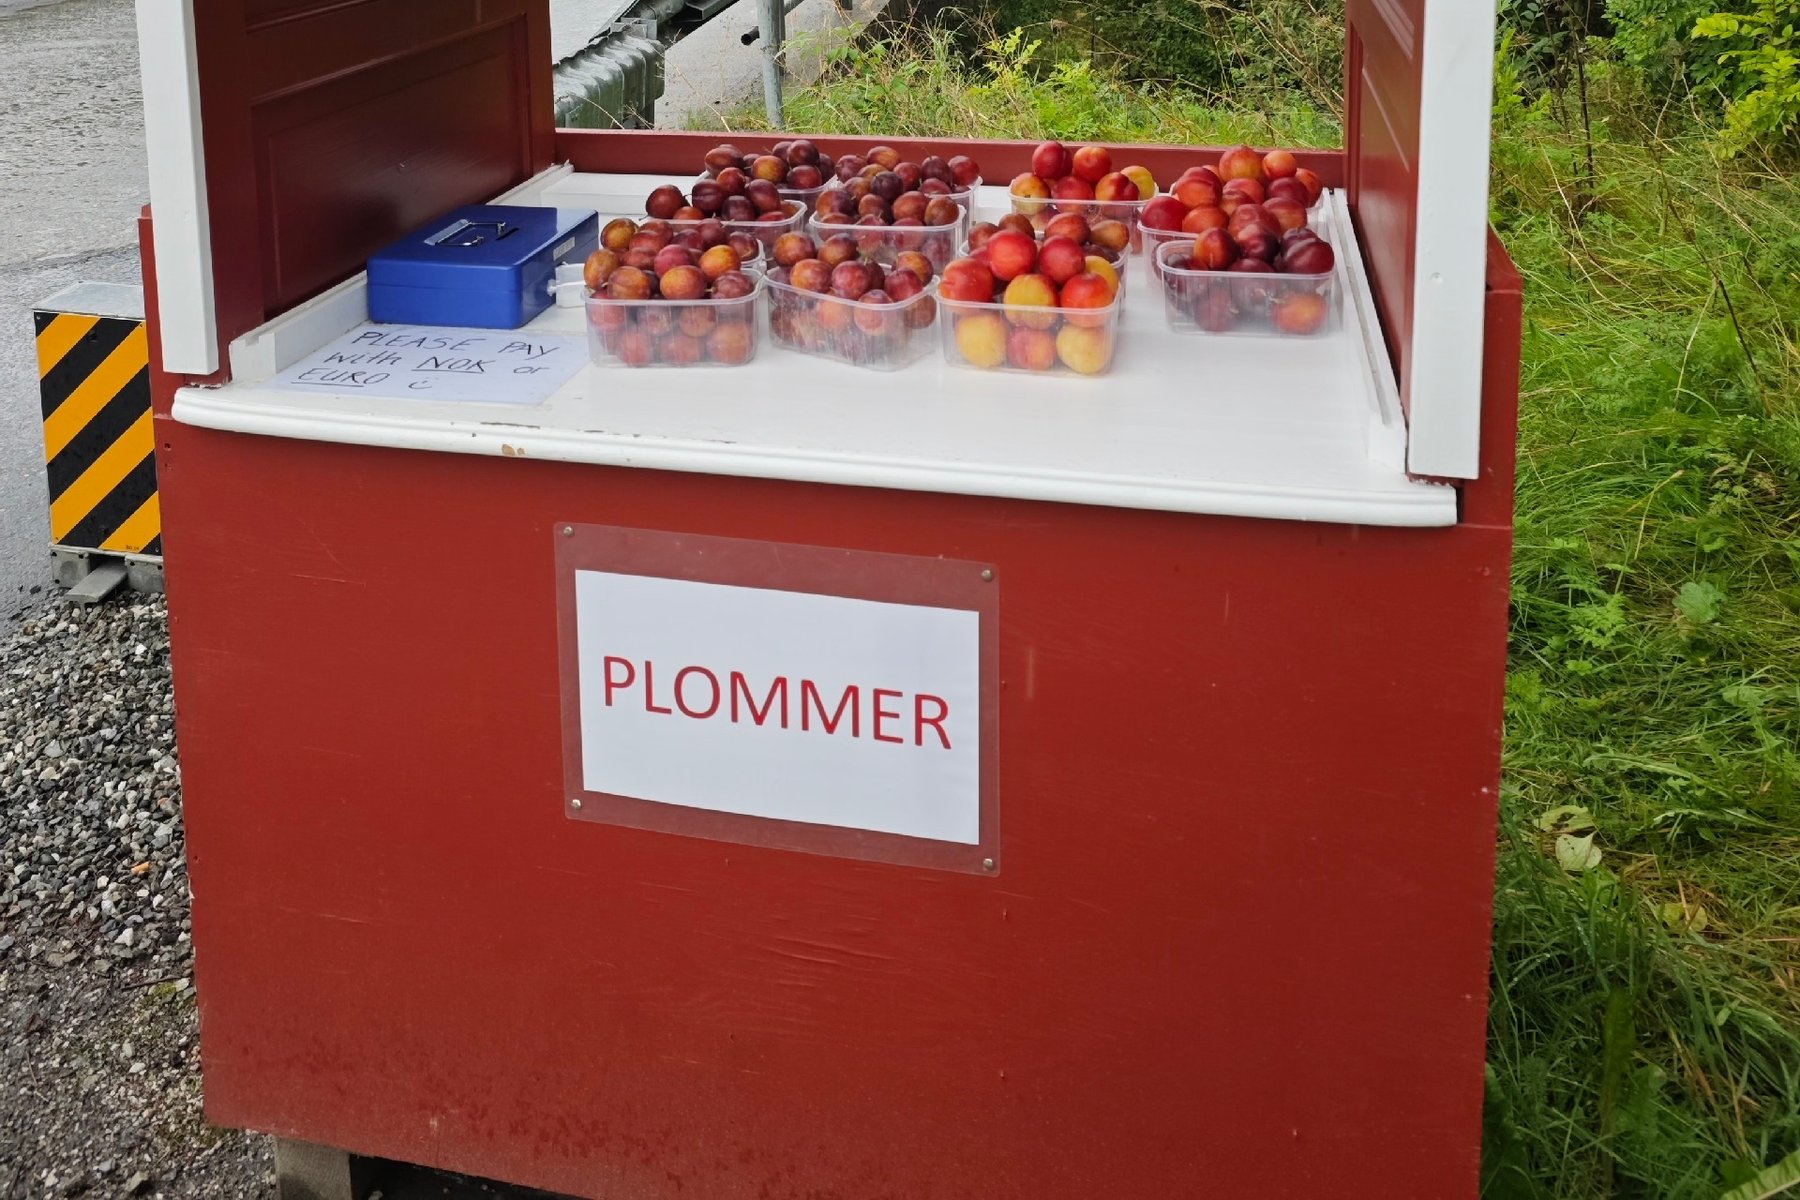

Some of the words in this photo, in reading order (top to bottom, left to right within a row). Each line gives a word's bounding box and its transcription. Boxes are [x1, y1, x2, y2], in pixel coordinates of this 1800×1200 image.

[352, 331, 486, 350] PLEASE
[497, 341, 560, 361] PAY
[324, 350, 403, 366] with
[415, 355, 497, 373] NOK
[512, 365, 550, 375] or
[297, 367, 391, 386] EURO
[602, 655, 952, 750] PLOMMER
